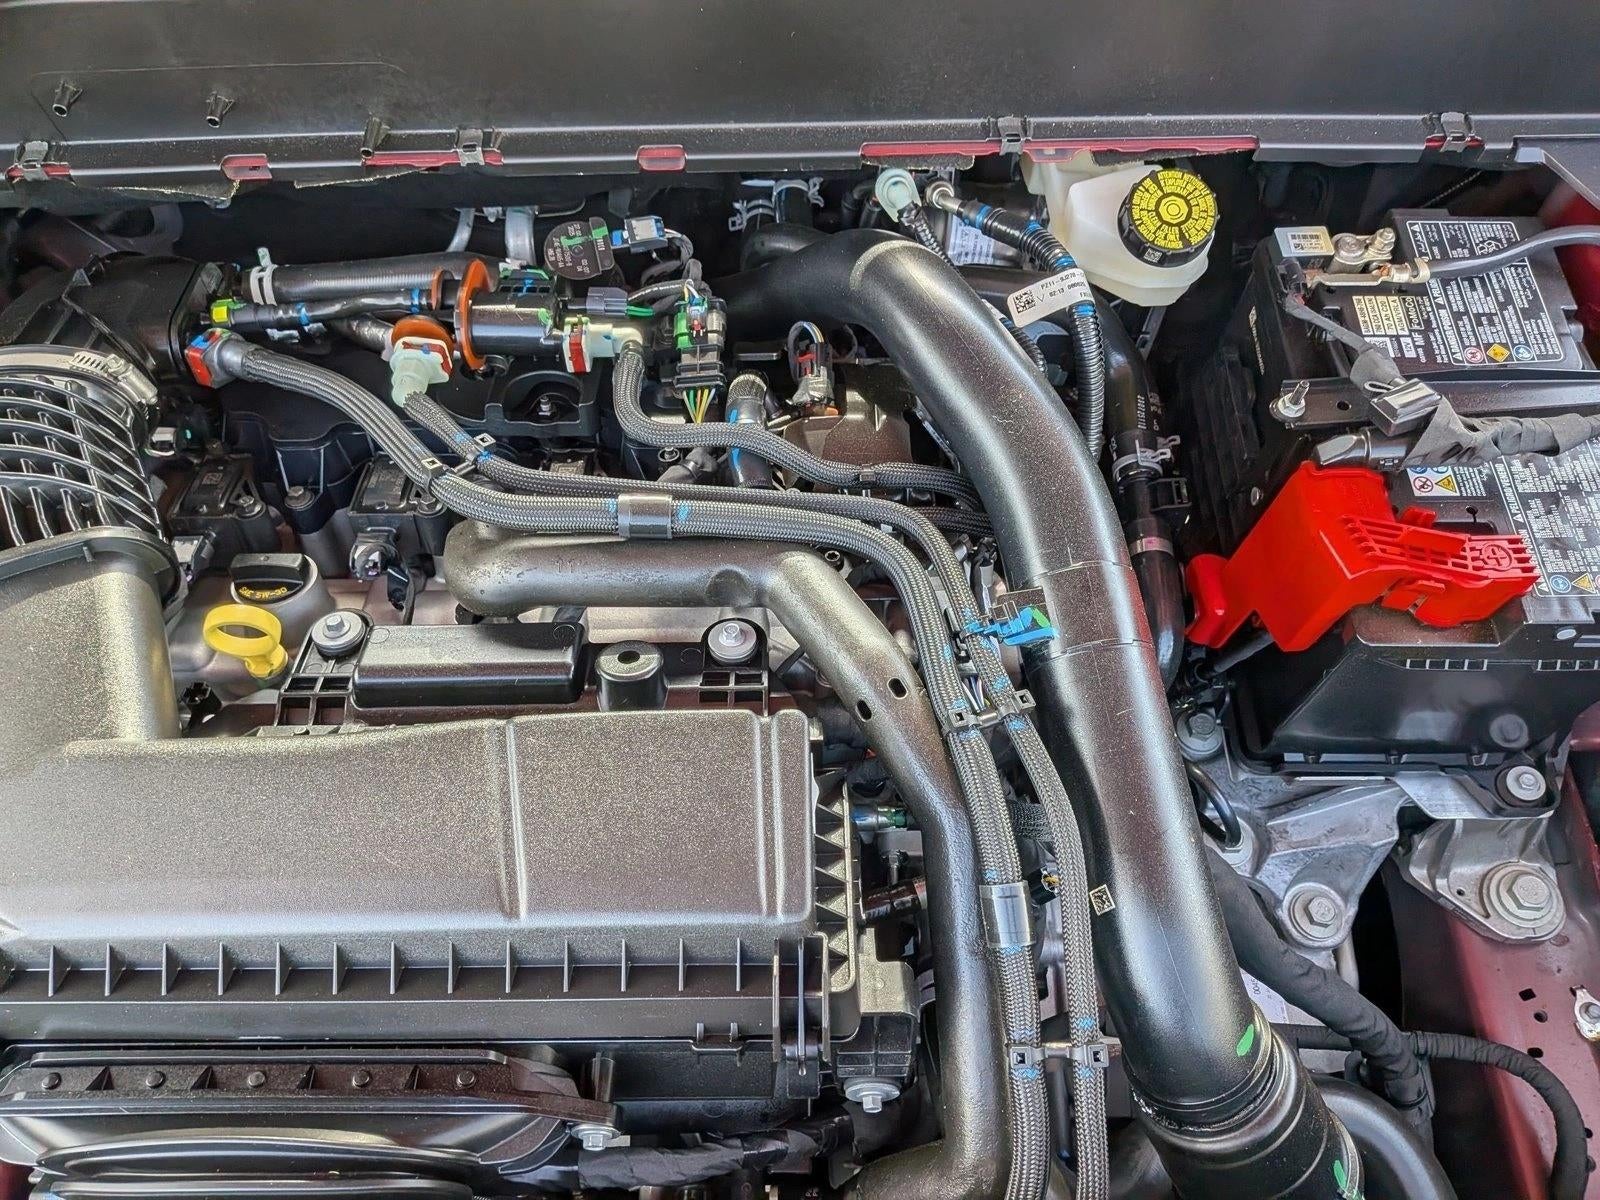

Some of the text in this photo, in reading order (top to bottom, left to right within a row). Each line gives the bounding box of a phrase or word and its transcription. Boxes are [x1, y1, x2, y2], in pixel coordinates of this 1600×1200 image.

[1379, 300, 1388, 312] C20
[1390, 299, 1406, 331] AGM/VRLA
[1406, 297, 1419, 327] FoMoCo
[1438, 309, 1459, 352] DANGER/POISON
[1403, 341, 1412, 352] 12V
[1495, 463, 1520, 514] PELIGRO/VENENO
[239, 586, 288, 599] SAE 5W-30
